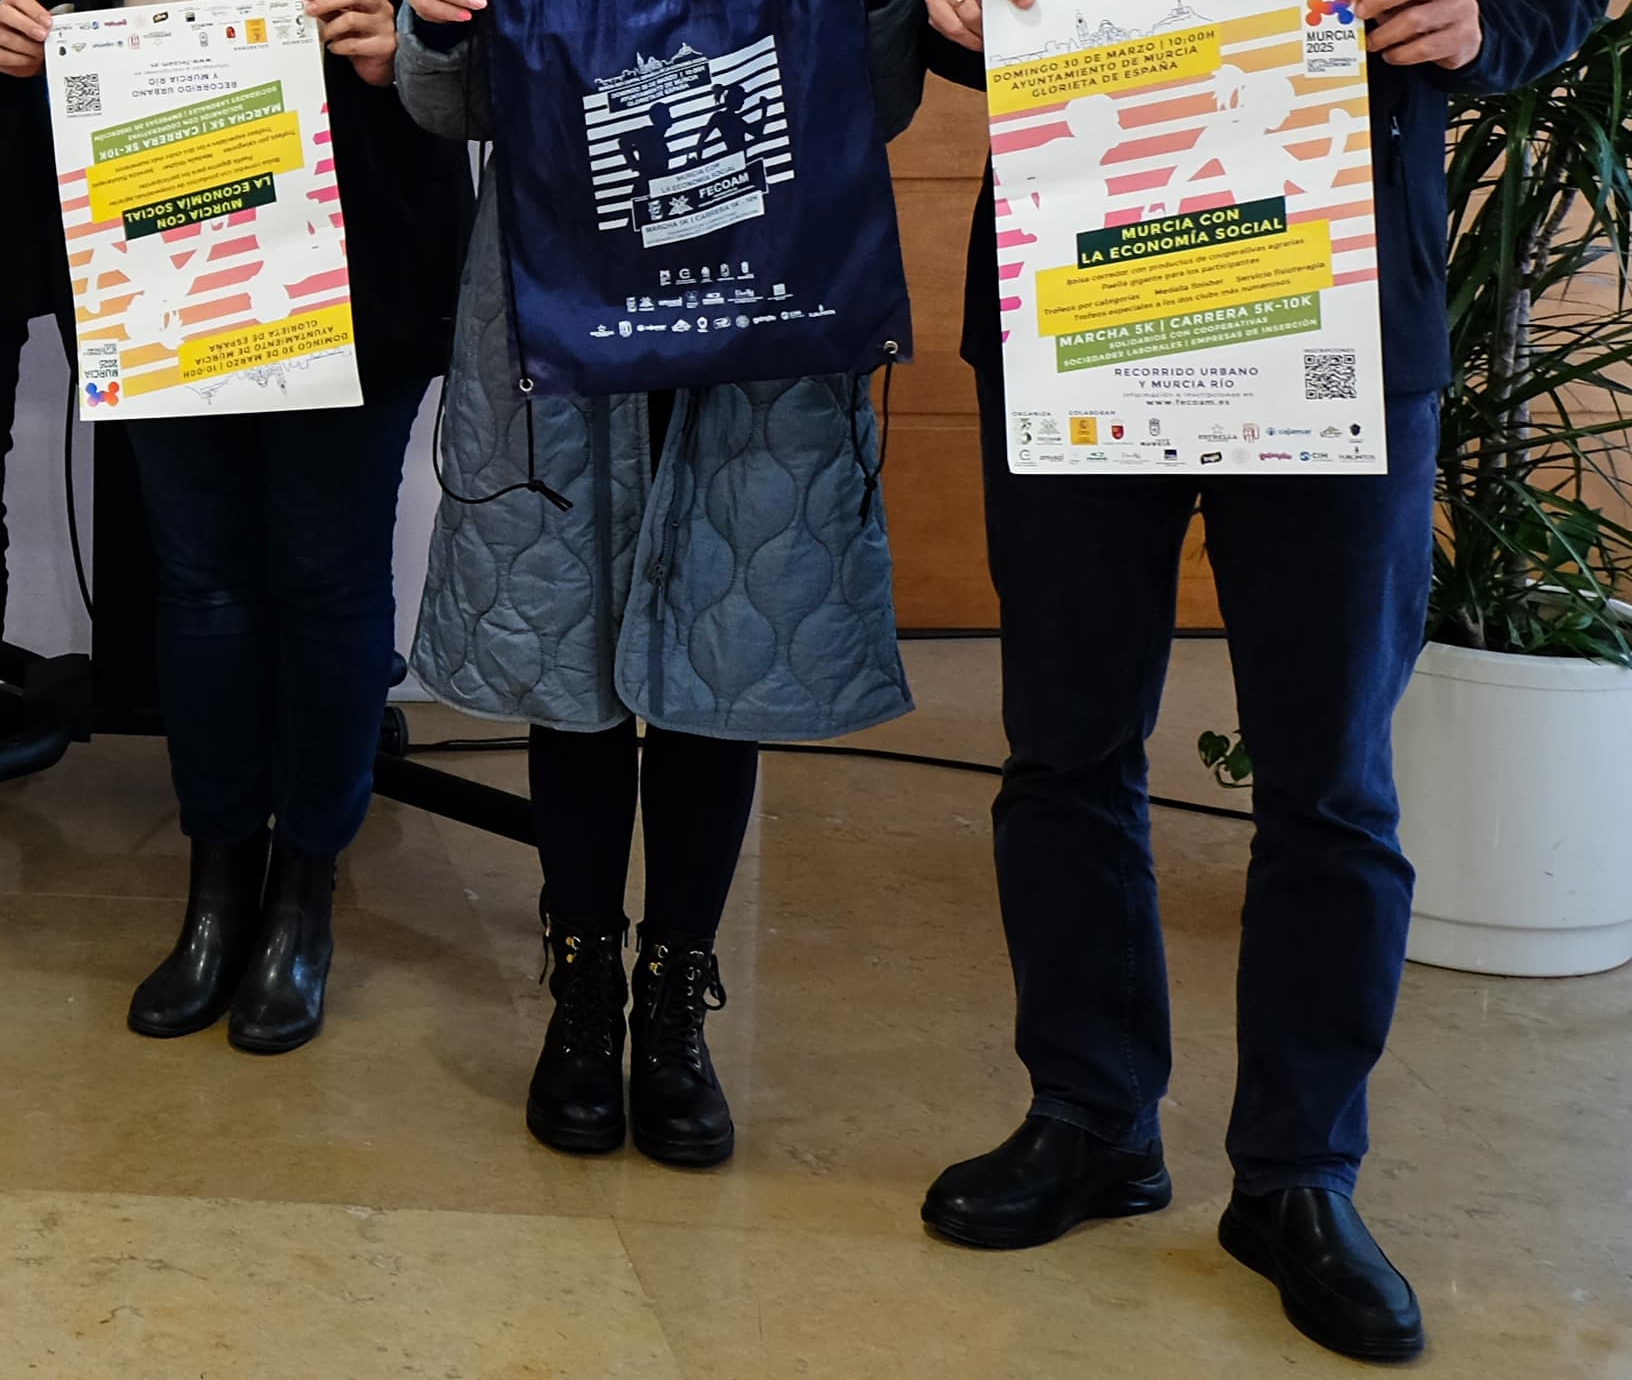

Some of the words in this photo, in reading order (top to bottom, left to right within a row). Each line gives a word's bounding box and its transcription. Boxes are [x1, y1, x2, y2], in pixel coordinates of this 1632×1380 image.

[1305, 28, 1356, 42] MURCIA
[1306, 41, 1335, 53] 2025
[698, 172, 749, 198] FECOAM
[1120, 216, 1194, 241] MURCIA
[1199, 207, 1240, 226] CON
[1080, 249, 1104, 264] LA
[1108, 227, 1210, 259] ECONOMÍA
[1214, 216, 1283, 240] SOCIAL
[1058, 325, 1130, 348] MARCHA
[1134, 320, 1155, 335] 5K
[1169, 304, 1249, 329] CARRERA
[1253, 293, 1313, 315] 5K-10K
[1114, 367, 1194, 377] RECORRIDO
[1199, 366, 1259, 376] URBANO
